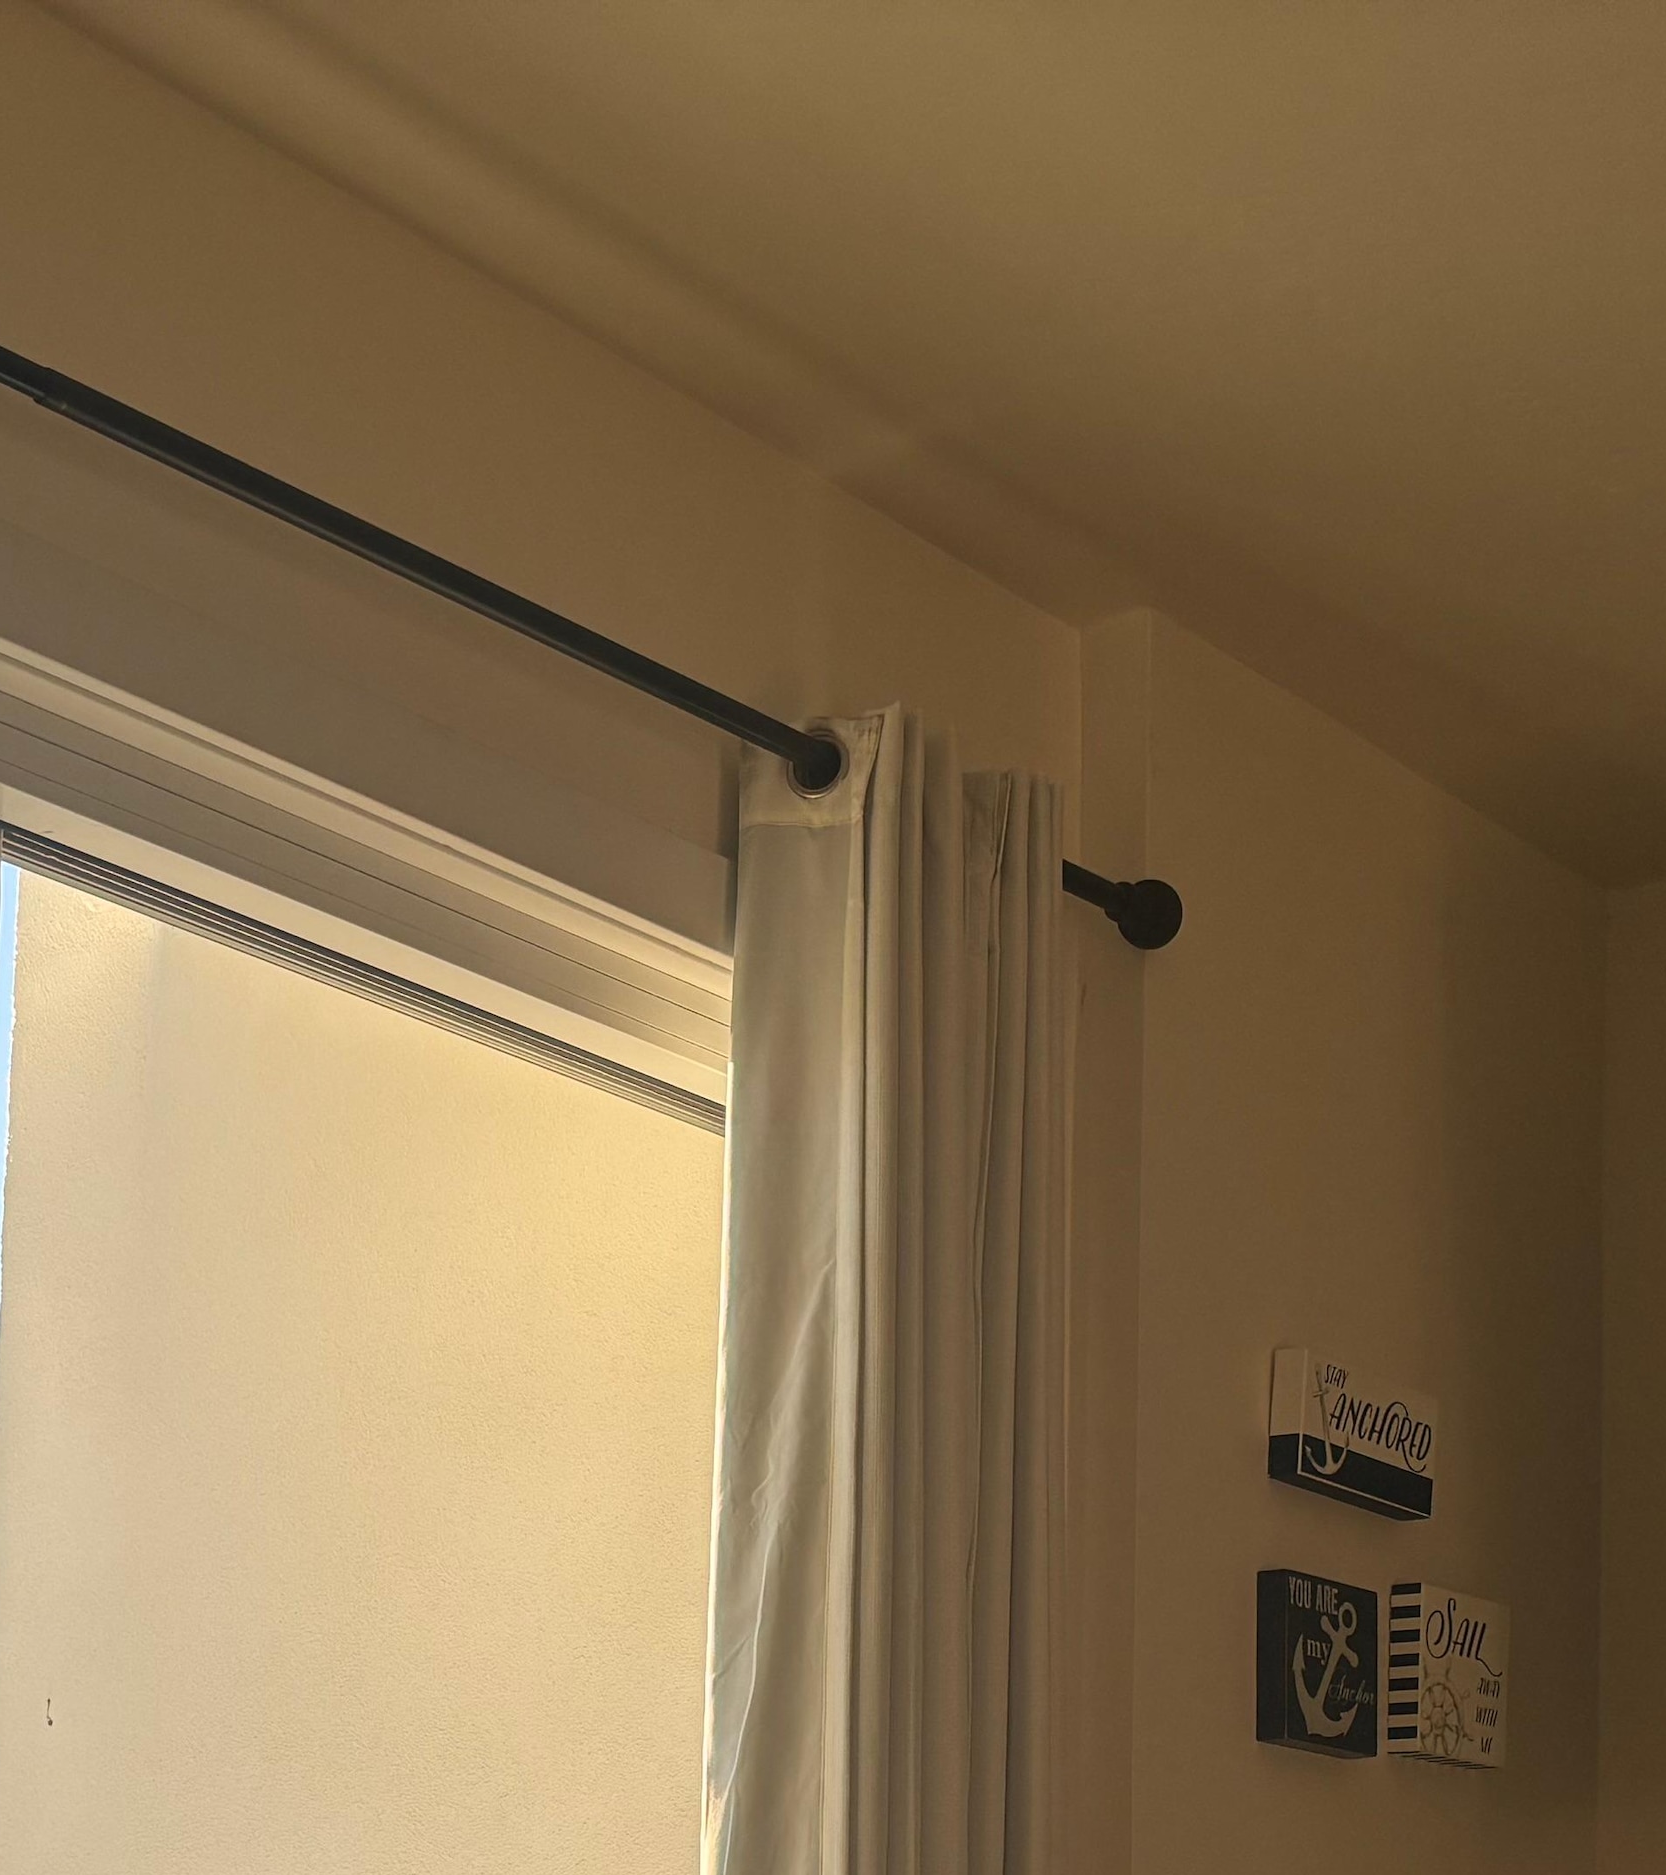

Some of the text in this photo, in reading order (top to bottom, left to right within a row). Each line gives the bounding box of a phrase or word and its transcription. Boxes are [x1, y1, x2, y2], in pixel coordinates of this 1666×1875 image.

[1324, 1363, 1349, 1389] STAY
[1329, 1393, 1432, 1473] ANCHORED
[1288, 1576, 1339, 1616] YOU ARE
[1306, 1638, 1332, 1666] my
[1328, 1674, 1375, 1706] Anchor
